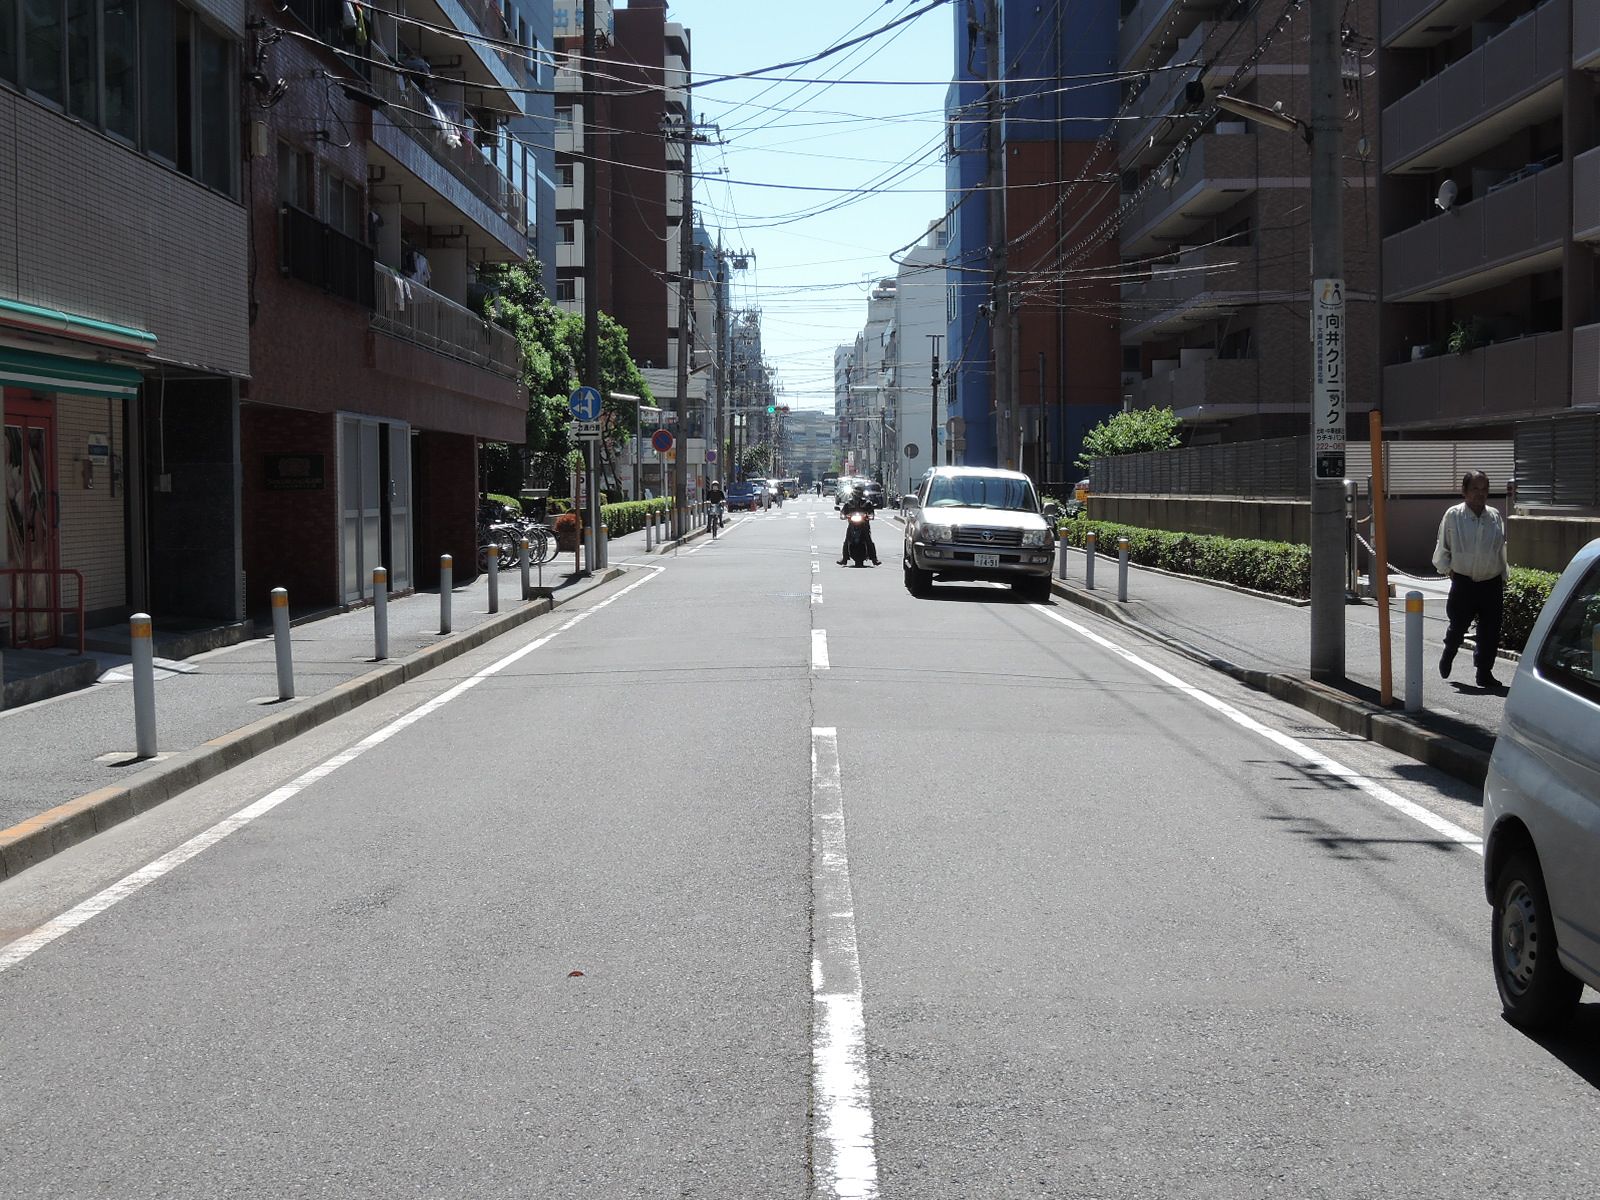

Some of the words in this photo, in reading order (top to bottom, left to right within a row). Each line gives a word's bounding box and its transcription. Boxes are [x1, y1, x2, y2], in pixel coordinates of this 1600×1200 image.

[1326, 314, 1340, 424] 向井クリニック
